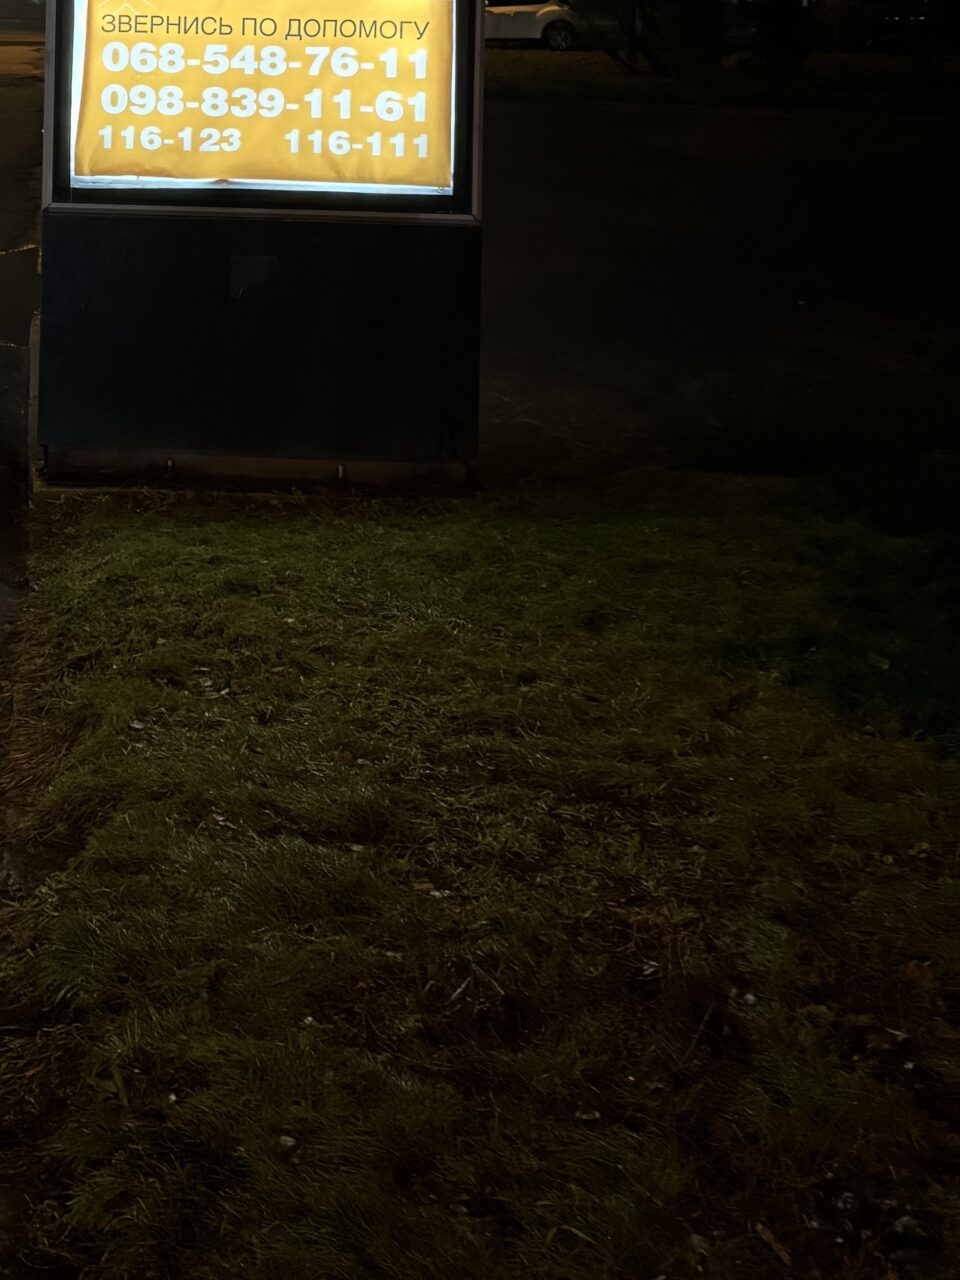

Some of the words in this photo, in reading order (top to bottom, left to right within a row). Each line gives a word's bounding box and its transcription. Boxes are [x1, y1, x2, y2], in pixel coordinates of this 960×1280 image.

[101, 14, 233, 35] ЗВЕРНИСЬ
[241, 17, 277, 37] ПО
[285, 18, 430, 41] ДОПОМОГУ
[102, 41, 428, 79] 068-548-76-11
[101, 83, 427, 122] 098-839-11-61
[98, 125, 241, 152] 116-123
[284, 128, 428, 159] 116-111
